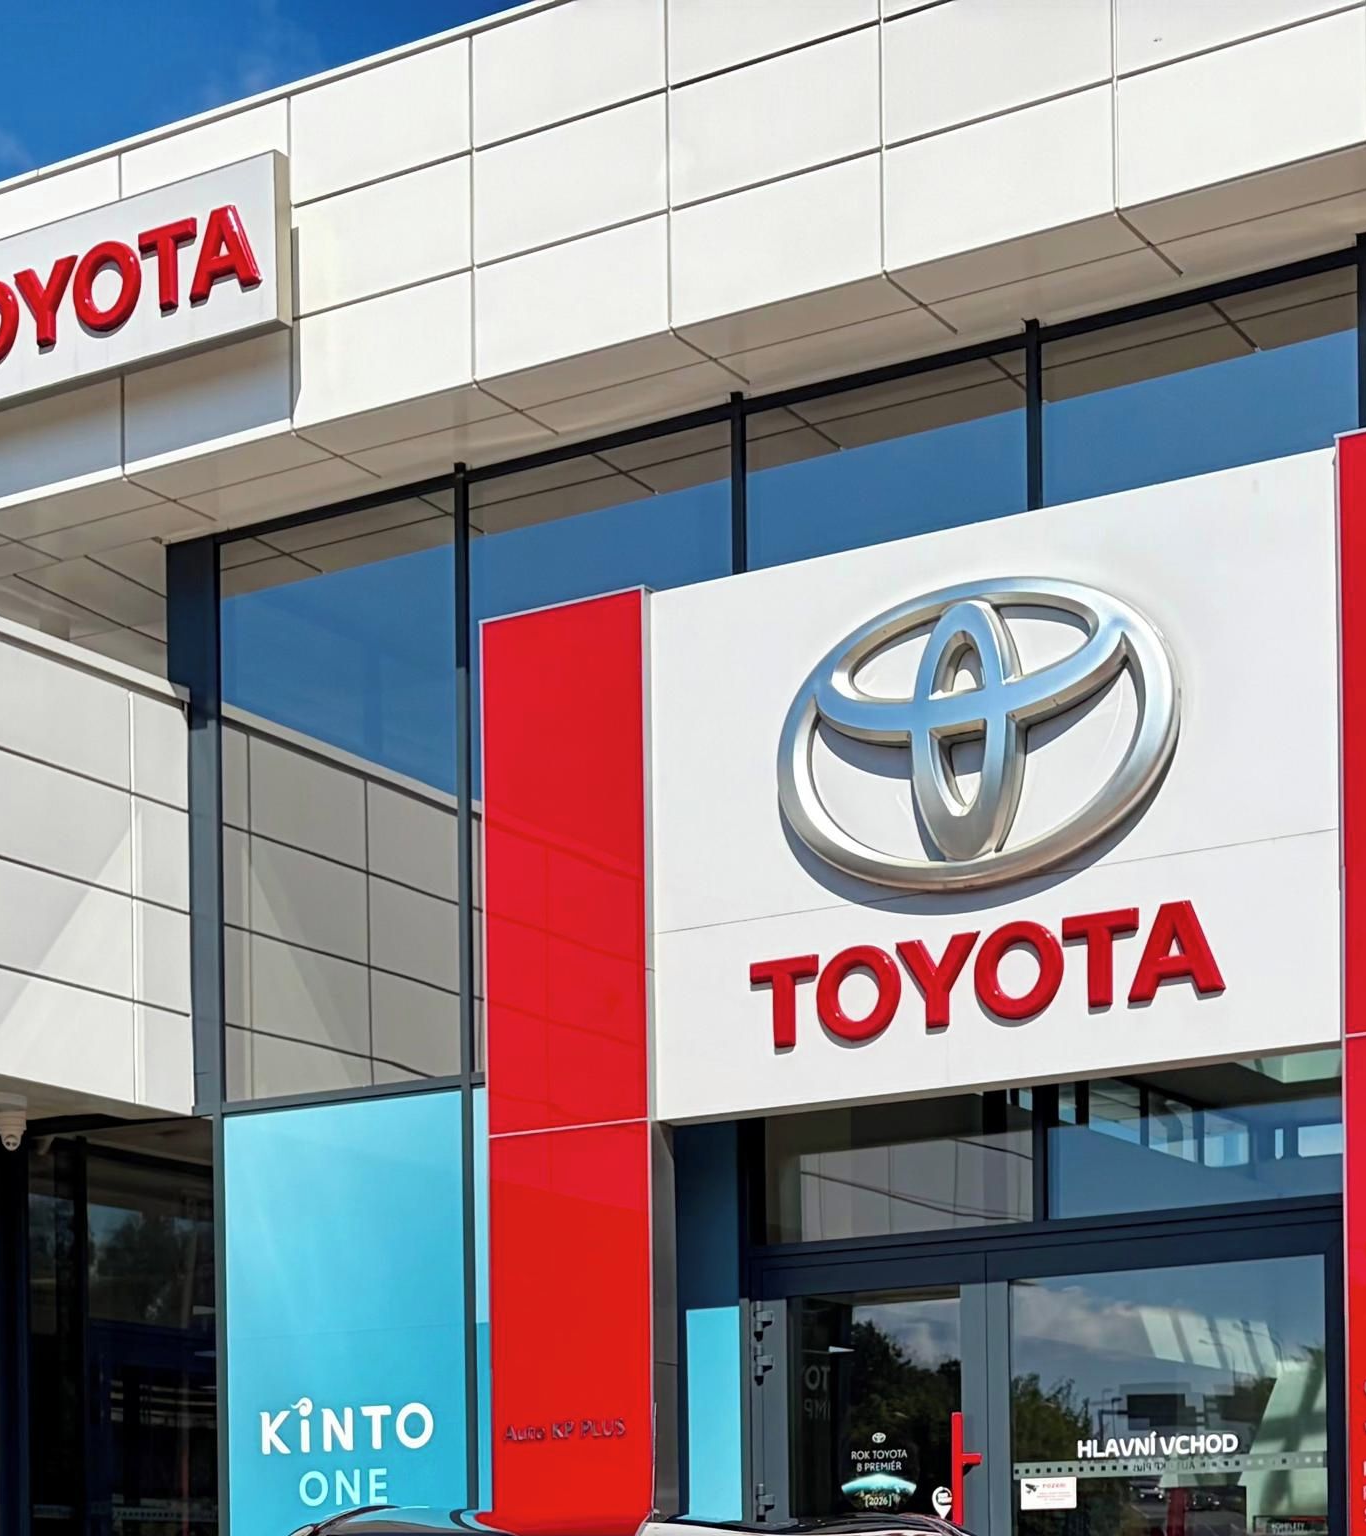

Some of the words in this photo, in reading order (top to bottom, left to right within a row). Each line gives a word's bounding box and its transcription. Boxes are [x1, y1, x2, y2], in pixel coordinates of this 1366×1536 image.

[749, 899, 1227, 1049] TOYOTA
[259, 1396, 434, 1455] KINTO
[552, 1421, 575, 1438] KP
[581, 1418, 626, 1438] PLUS
[851, 1450, 870, 1460] ROK
[873, 1449, 907, 1459] TOYOTA
[1077, 1431, 1157, 1458] HLAVNÍ
[1160, 1433, 1239, 1456] VCHOD
[864, 1461, 902, 1472] PREMIÉR
[299, 1468, 389, 1507] ONE
